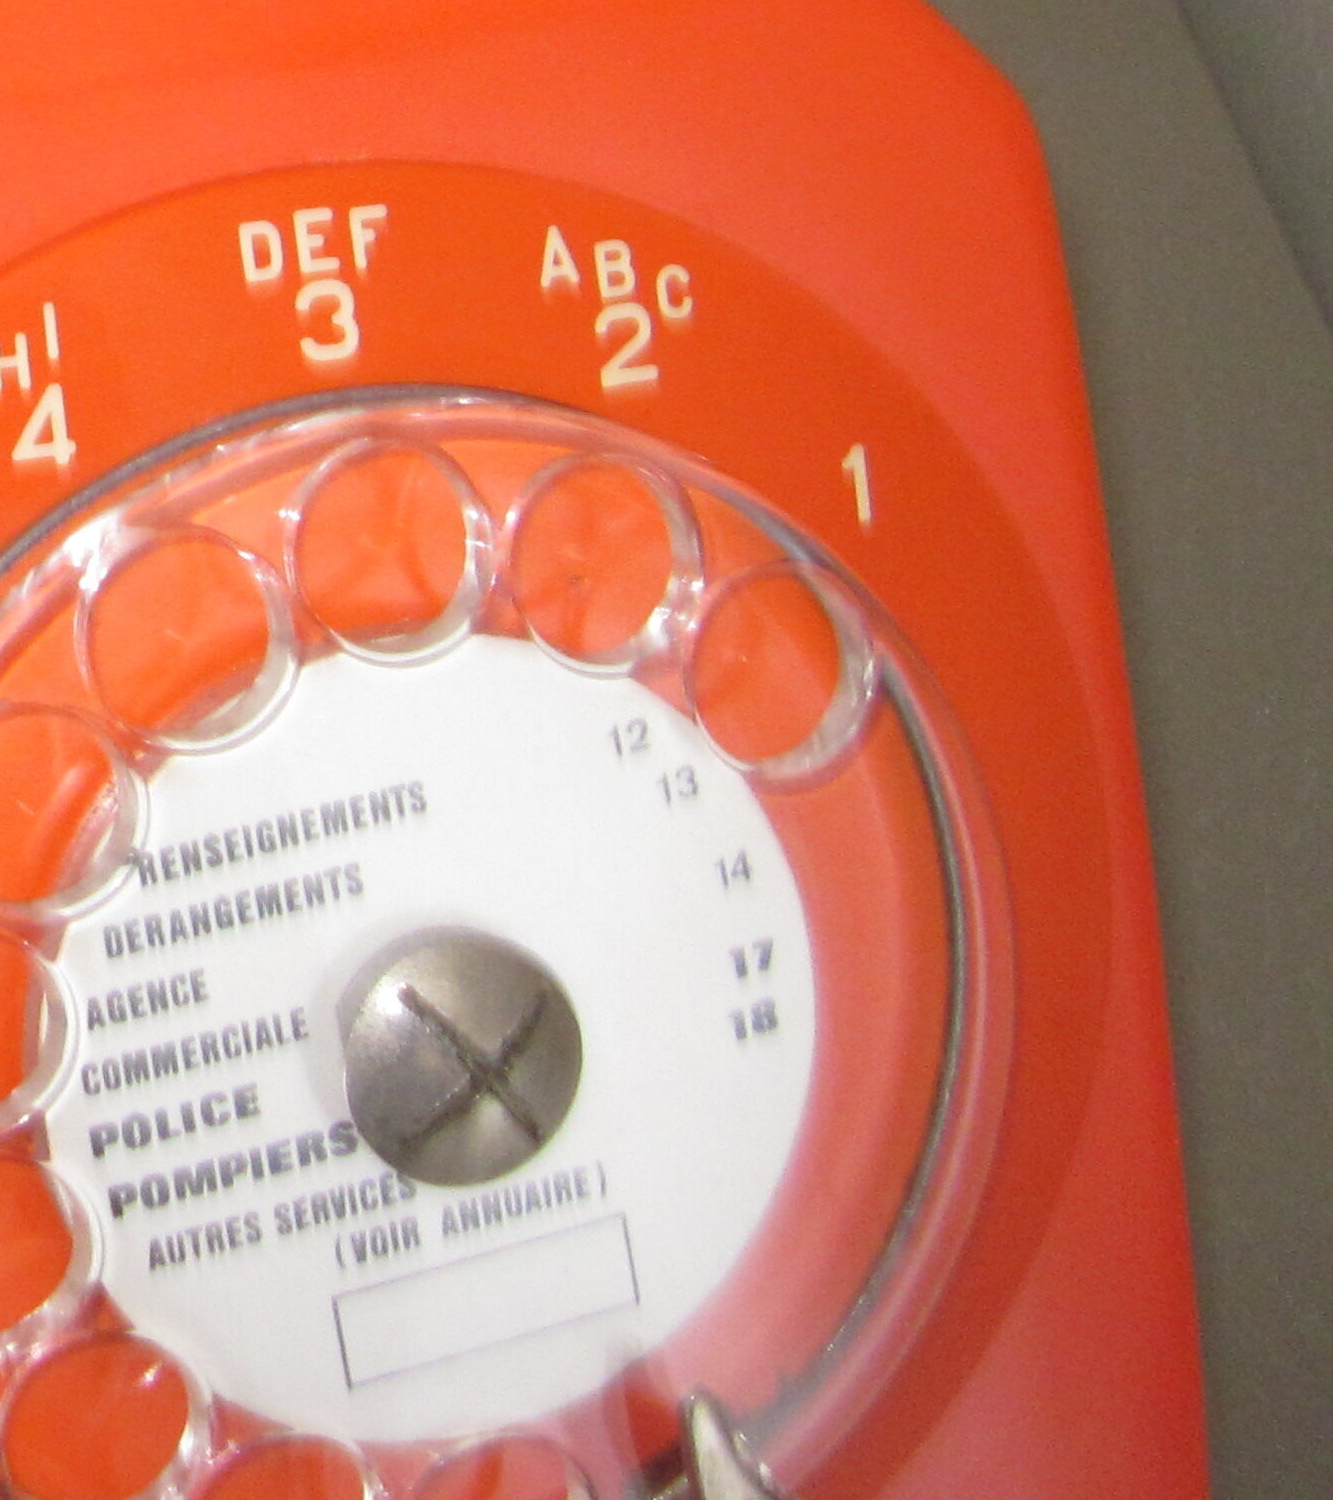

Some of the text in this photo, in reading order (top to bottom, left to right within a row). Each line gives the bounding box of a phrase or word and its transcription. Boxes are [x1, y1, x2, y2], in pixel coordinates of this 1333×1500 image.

[239, 203, 388, 284] DEF
[540, 225, 692, 320] ABC
[295, 279, 360, 363] 3
[595, 303, 658, 388] 2
[12, 383, 76, 466] 4
[842, 443, 872, 524] 1
[610, 717, 650, 757] 12
[658, 765, 698, 806] 13
[103, 862, 364, 958] DERANGEMENTS
[716, 849, 751, 890] 14
[729, 938, 775, 979] 17
[86, 967, 210, 1032] AGENCE
[729, 999, 779, 1041] 18
[80, 1006, 309, 1097] COMMERCIALE
[88, 1082, 262, 1158] POLICE
[107, 1120, 359, 1219] POMPIERS
[149, 1171, 417, 1272] AUTRES SERVICES
